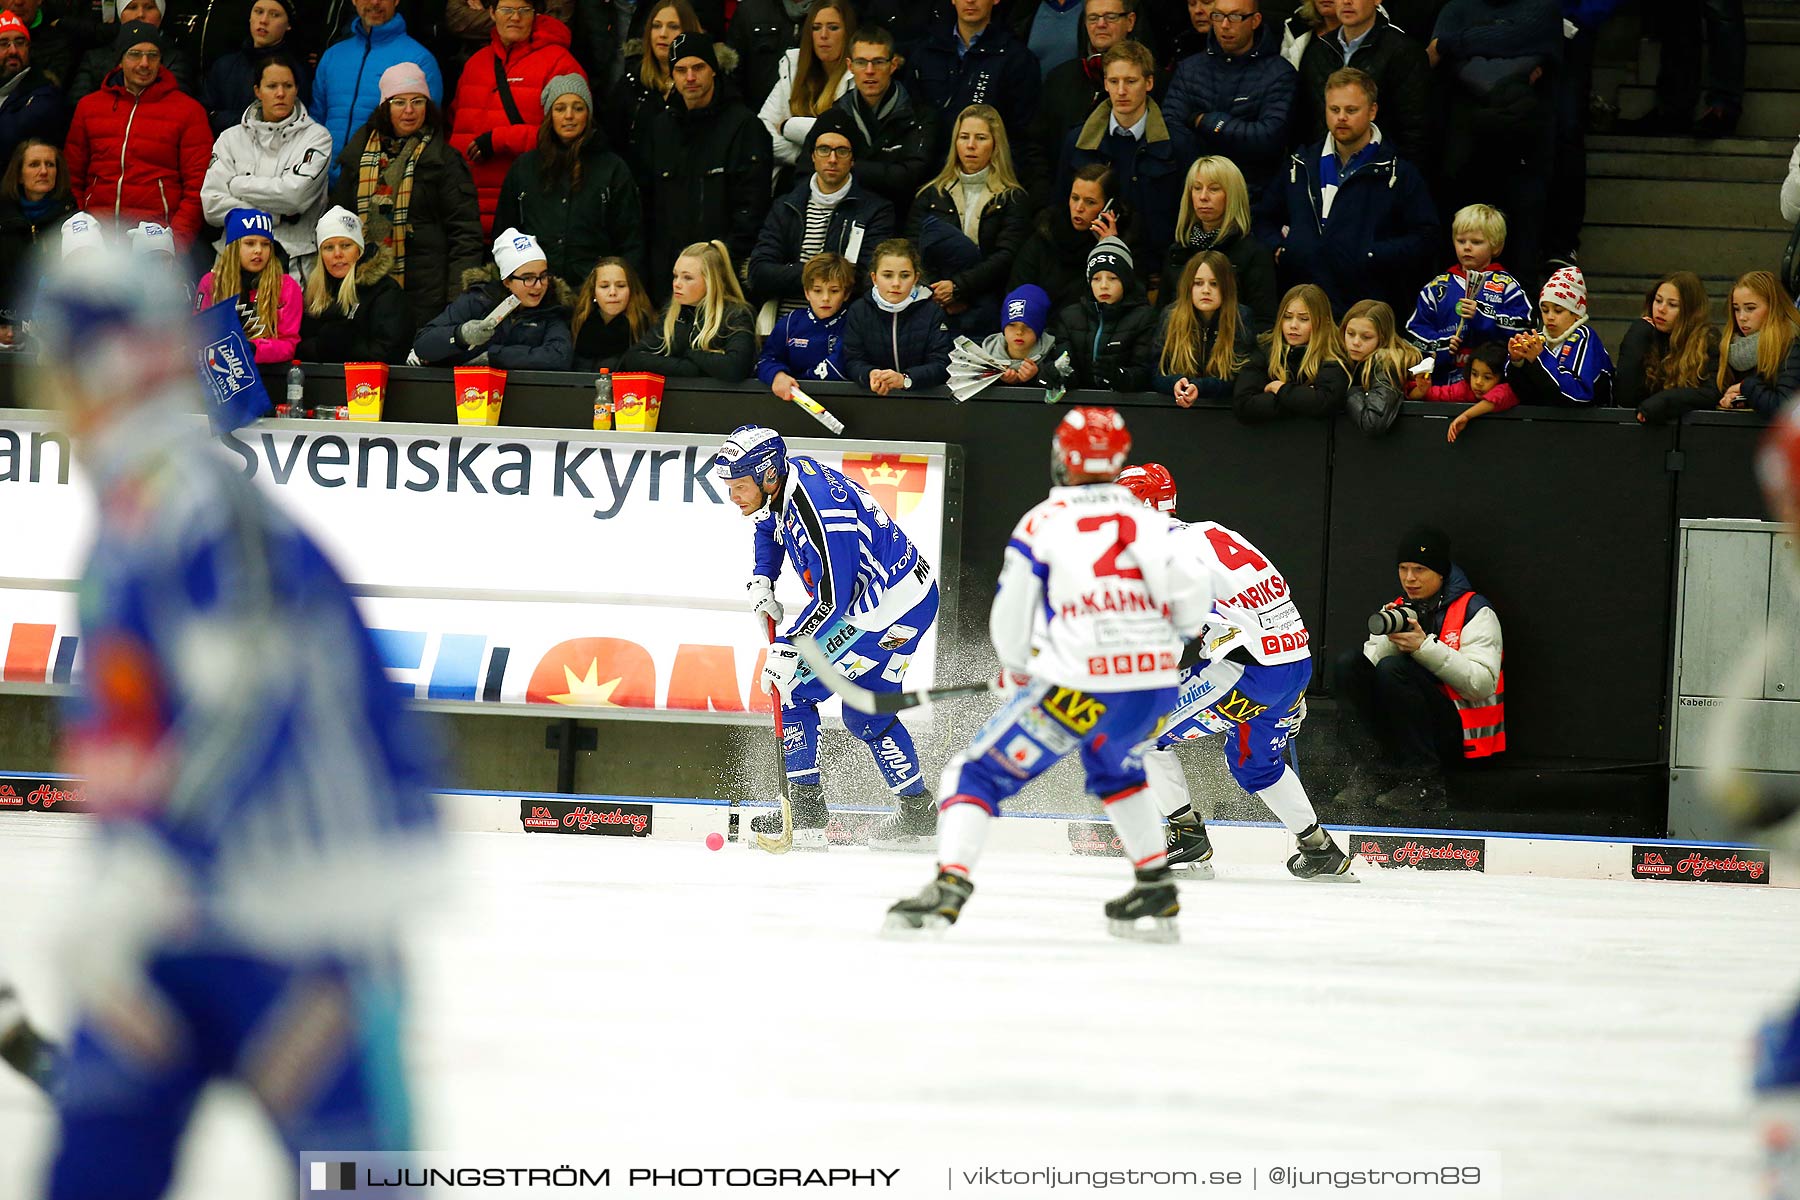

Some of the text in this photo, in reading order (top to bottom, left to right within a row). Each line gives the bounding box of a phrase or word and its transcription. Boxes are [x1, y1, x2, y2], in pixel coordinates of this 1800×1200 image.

[1076, 513, 1144, 580] 2
[1203, 527, 1268, 572] 4
[0, 785, 16, 796] CA
[531, 807, 552, 818] ICA
[563, 807, 648, 832] Hjertberg
[1361, 842, 1381, 853] ICA
[1393, 841, 1480, 867] Hjertberg
[1644, 852, 1665, 865] ICA
[1676, 852, 1765, 879] Hjertberg
